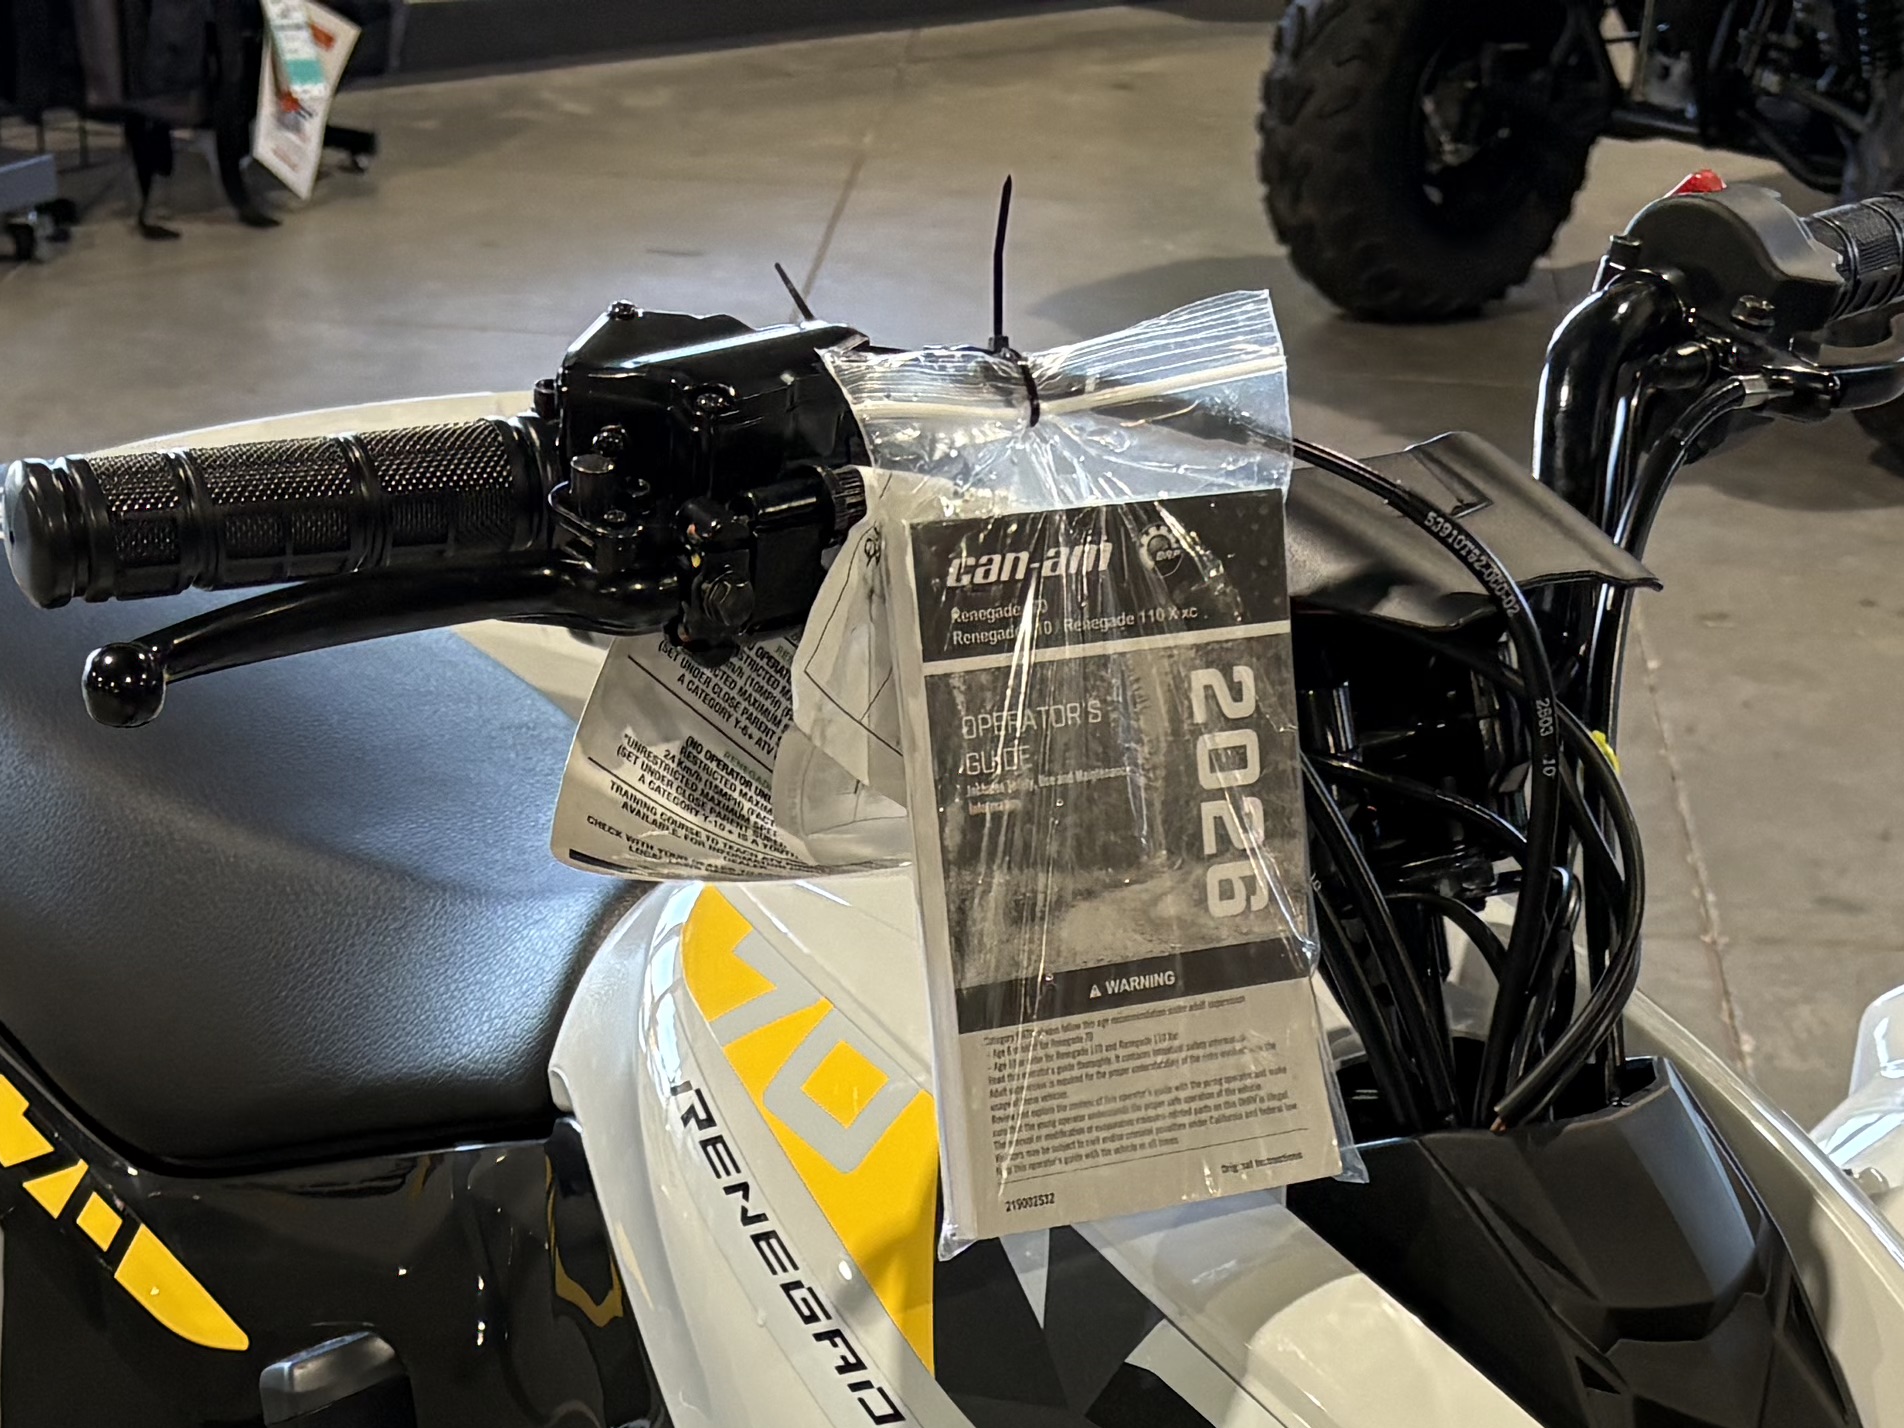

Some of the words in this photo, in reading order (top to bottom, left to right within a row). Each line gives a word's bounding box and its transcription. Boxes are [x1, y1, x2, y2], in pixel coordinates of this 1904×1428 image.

[946, 542, 1113, 588] can-am
[952, 602, 1022, 624] Renegade
[1063, 611, 1135, 634] Renegade
[1137, 607, 1164, 626] 110
[962, 699, 1102, 740] OPERATOR'S
[1191, 665, 1269, 918] 2026
[1105, 969, 1176, 995] WARNING
